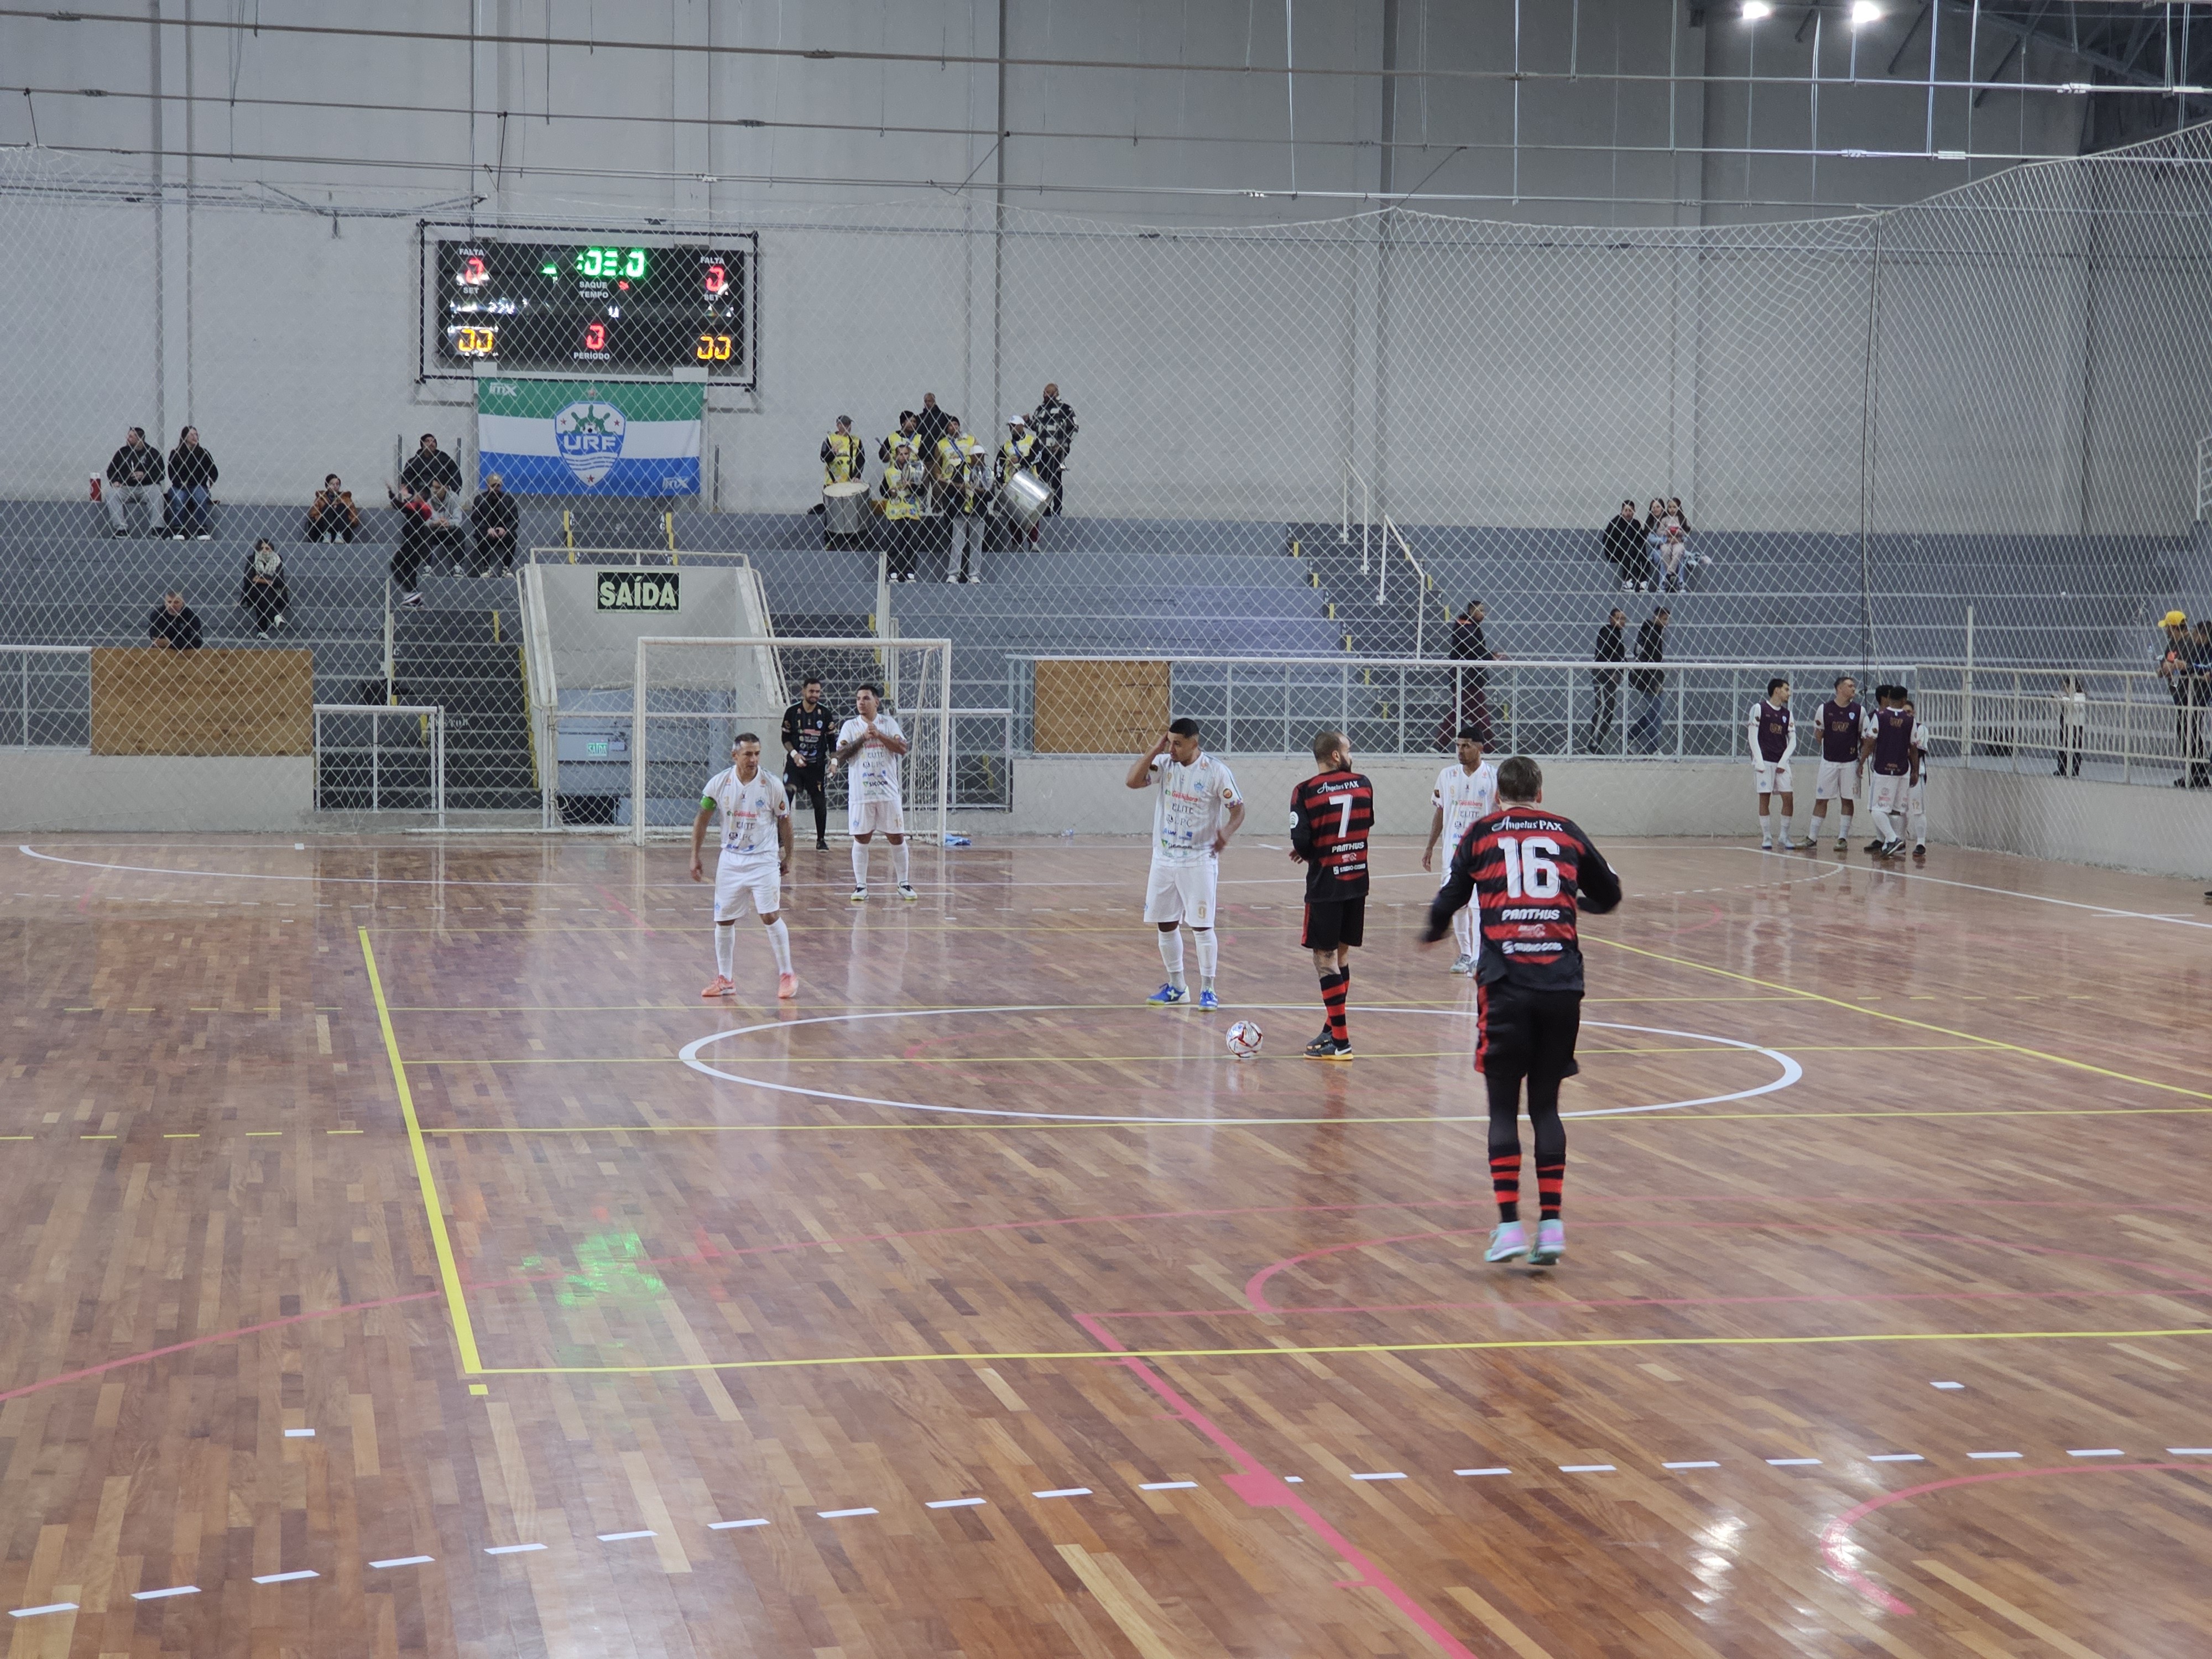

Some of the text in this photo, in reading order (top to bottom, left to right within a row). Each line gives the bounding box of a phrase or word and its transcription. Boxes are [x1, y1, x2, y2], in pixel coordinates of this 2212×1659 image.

[573, 351, 610, 360] PERÍODO
[564, 435, 616, 451] URF
[600, 576, 677, 607] SAÍDA
[588, 743, 607, 754] SAÍDA
[1317, 780, 1359, 794] Angelus PAX
[1172, 802, 1194, 815] ELITE
[1328, 793, 1353, 838] 7
[1491, 816, 1563, 832] Angelus PAX
[1332, 841, 1365, 853] PANTHUS
[1498, 836, 1561, 899] 16
[1501, 909, 1561, 921] PANTHUS
